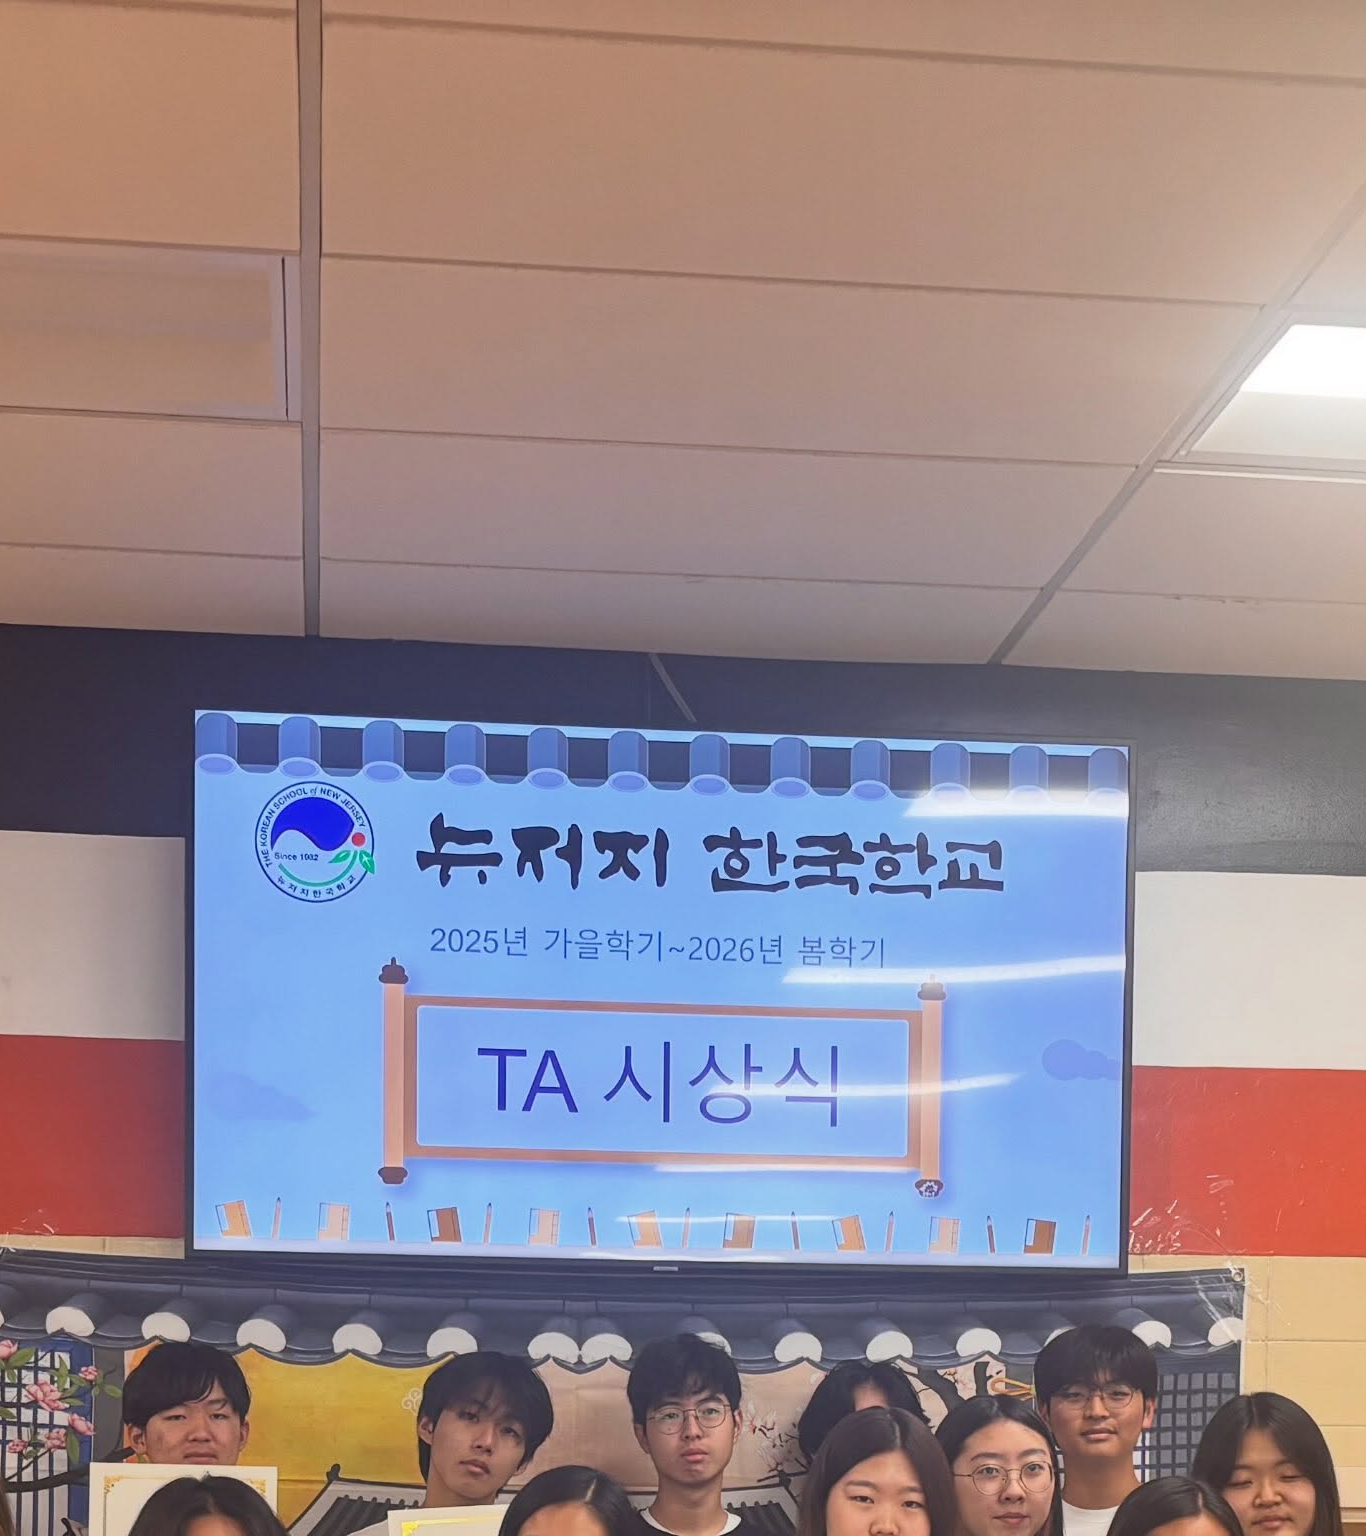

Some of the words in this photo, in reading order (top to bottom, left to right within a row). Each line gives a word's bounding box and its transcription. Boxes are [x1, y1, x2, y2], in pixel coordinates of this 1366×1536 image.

[259, 808, 275, 847] KOREAN
[273, 787, 308, 810] SCHOOL
[320, 787, 341, 800] NEW
[340, 797, 366, 828] JERSEY
[274, 852, 297, 861] Since
[416, 812, 667, 890] 뉴저지
[703, 826, 1006, 899] 한국학교
[429, 927, 531, 958] 2025년
[796, 937, 887, 969] 봄학기
[477, 1047, 579, 1113] TA
[602, 1040, 841, 1129] 시상식
